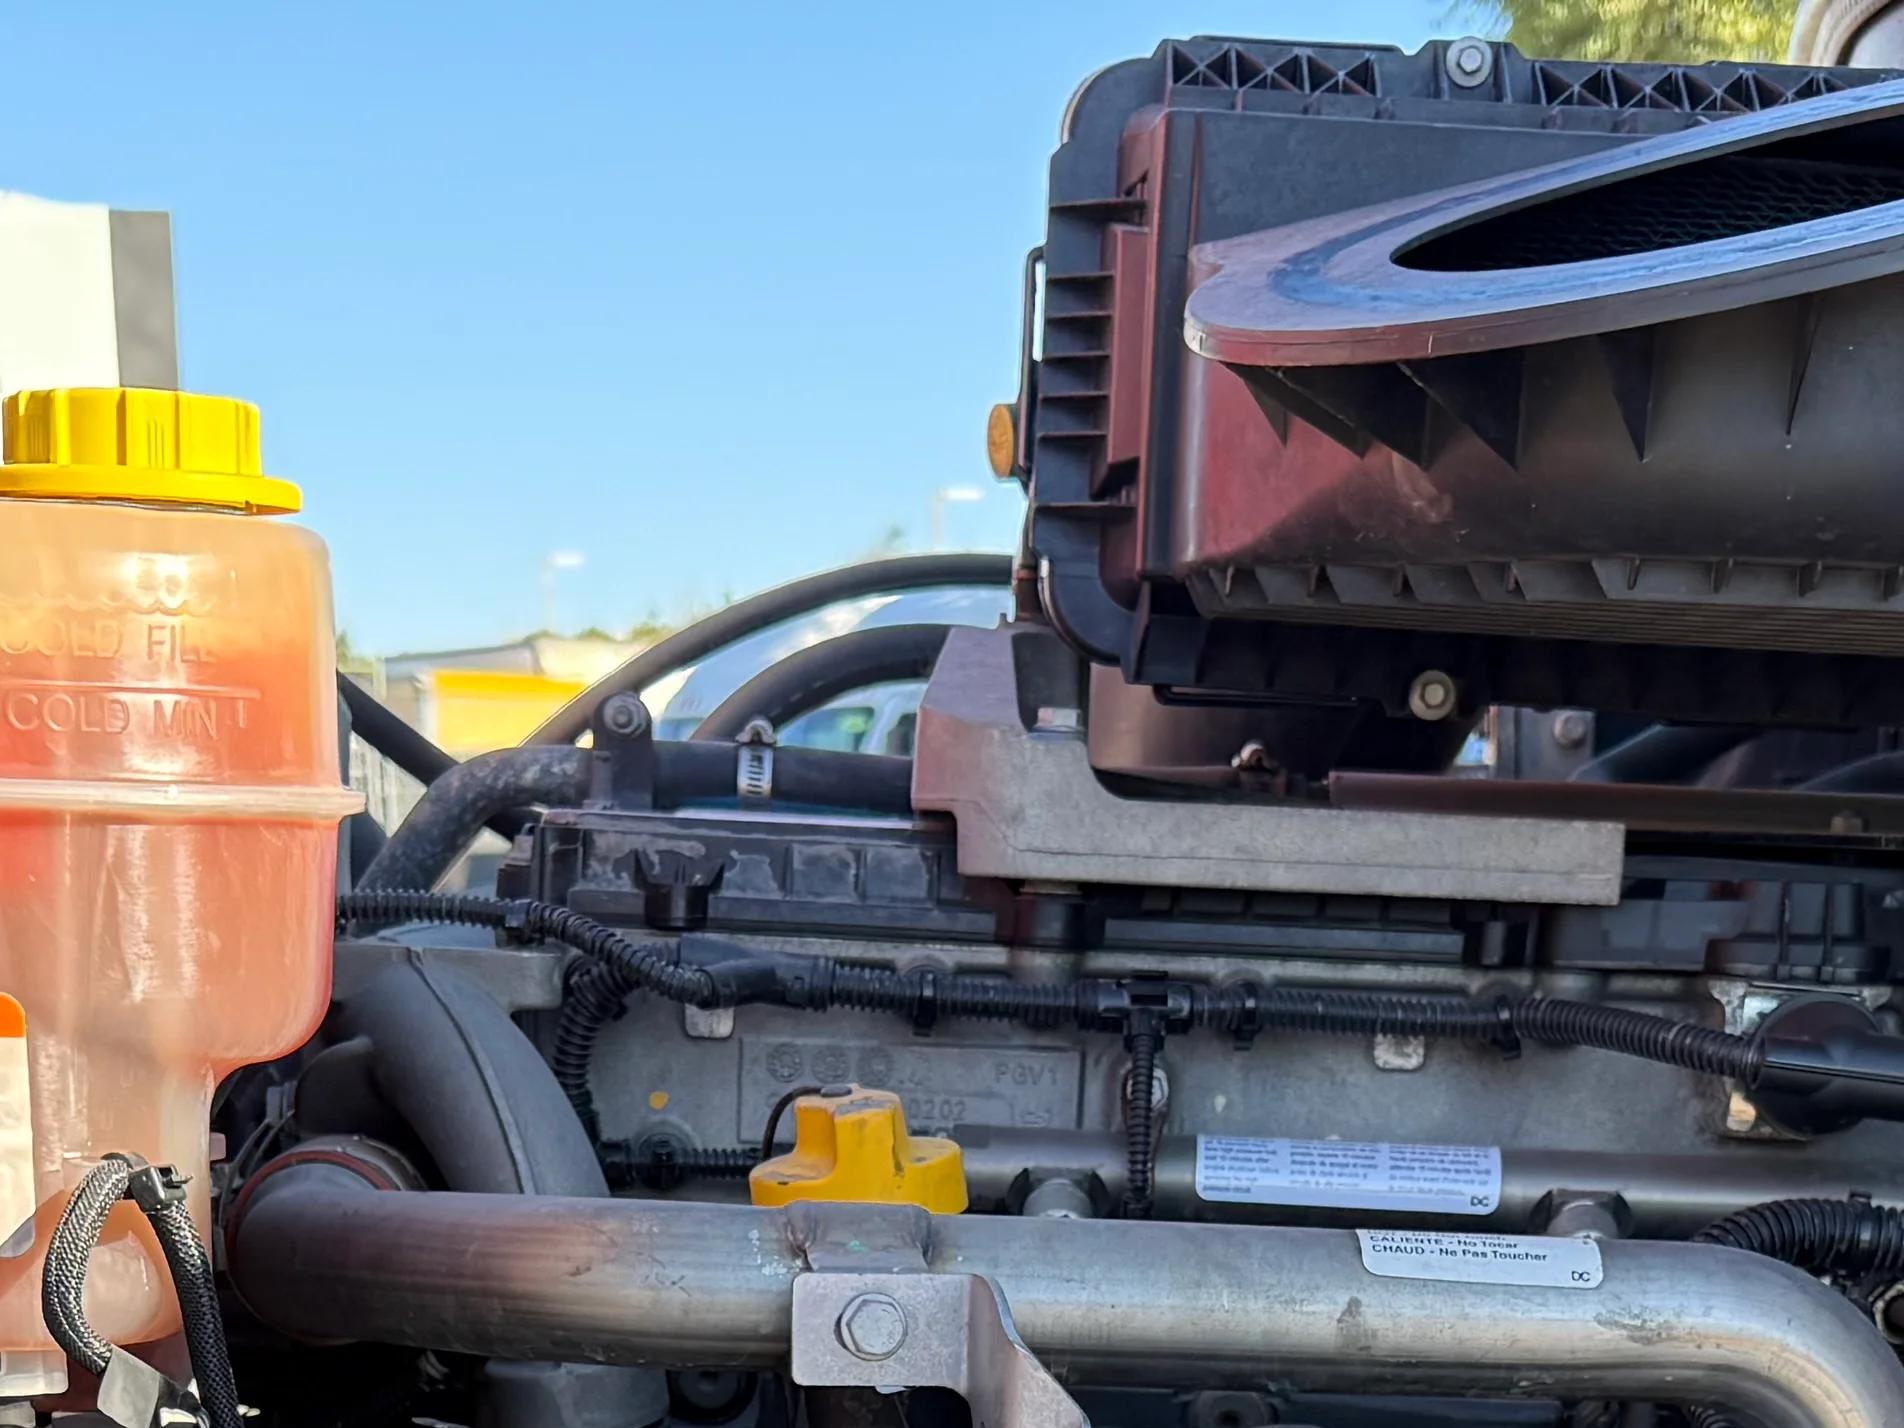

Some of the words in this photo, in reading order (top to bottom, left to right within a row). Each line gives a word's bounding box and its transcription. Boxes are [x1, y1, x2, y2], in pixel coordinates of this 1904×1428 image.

[7, 692, 130, 735] COLD
[1470, 1195, 1490, 1208] DC
[1370, 1235, 1445, 1247] CALIENTE
[1457, 1239, 1478, 1248] No
[1481, 1240, 1521, 1250] Tocar
[1372, 1243, 1426, 1256] CHAUD
[1439, 1248, 1459, 1258] Ne
[1462, 1249, 1488, 1259] Pas
[1491, 1250, 1549, 1262] Toucher
[1571, 1271, 1592, 1283] DC
